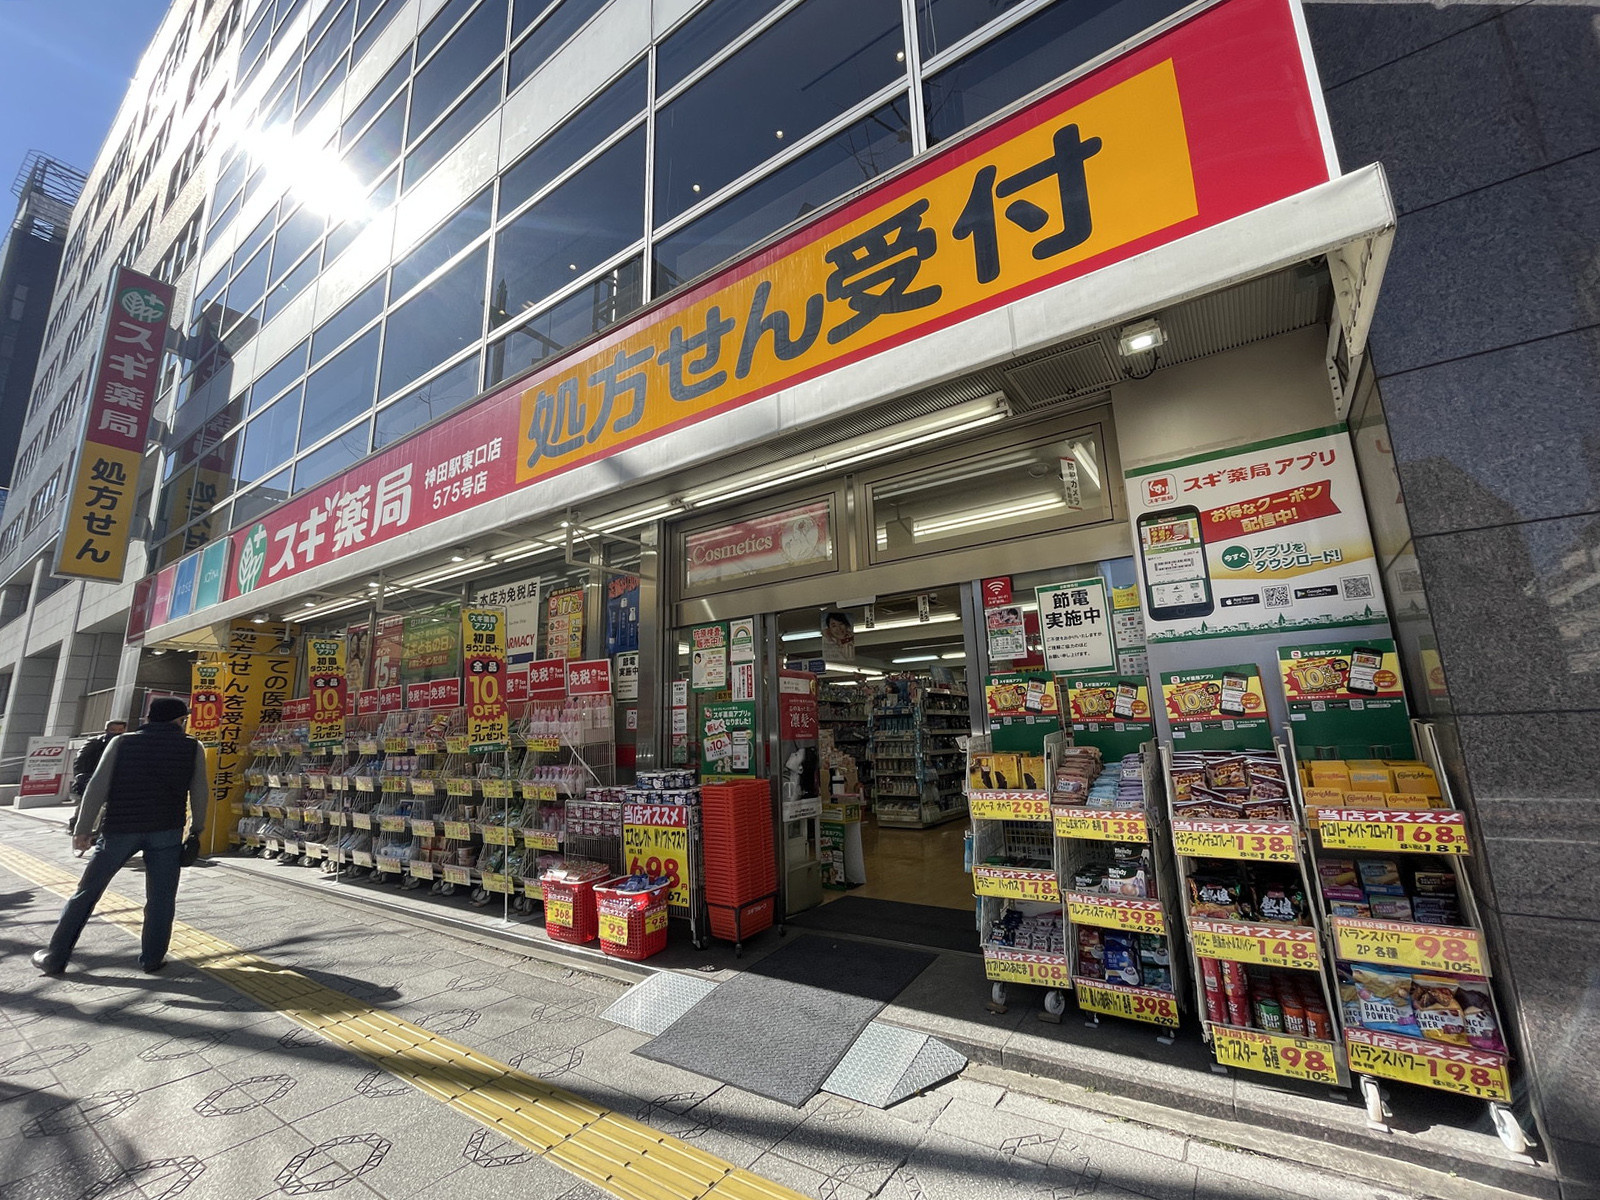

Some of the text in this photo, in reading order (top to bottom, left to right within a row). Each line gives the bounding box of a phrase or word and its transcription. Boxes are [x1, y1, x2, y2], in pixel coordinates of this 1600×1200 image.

[526, 122, 1102, 468] 処方せん受付
[98, 321, 155, 438] スギ薬局
[424, 437, 503, 489] 神田駅東口店
[1183, 449, 1336, 492] スギ薬局 アプリ
[433, 471, 488, 510] 575号店
[1066, 462, 1080, 505] 防犯カメラ
[76, 458, 127, 563] 処方せん
[1210, 485, 1323, 523] お得なクーポン
[268, 462, 413, 578] スギ薬局
[1241, 506, 1298, 533] 配信中!
[692, 533, 773, 565] Cosmetics
[1253, 543, 1304, 558] アプリを
[1224, 551, 1247, 563] 今すぐ
[1255, 549, 1342, 573] ダウンロード!
[480, 582, 538, 608] 本店为免税店
[1052, 589, 1089, 609] 節電
[1045, 607, 1101, 629] 実施中
[474, 623, 494, 631] アプリ
[473, 633, 496, 644] 初回
[472, 661, 498, 672] 全品
[530, 667, 549, 683] 免税
[570, 669, 591, 685] 免税
[431, 687, 446, 700] 免税
[506, 679, 514, 693] 税
[314, 710, 340, 721] OFF
[472, 705, 501, 717] OFF
[195, 720, 217, 728] OFF
[315, 724, 341, 732] クーポン
[474, 723, 503, 733] クーポン
[706, 721, 724, 732] 新しく
[471, 732, 506, 743] プレゼント
[32, 748, 62, 756] TKP
[969, 792, 1047, 800] 当店オススメ
[624, 805, 687, 825] 当店オススメ!
[1054, 809, 1143, 820] 当店オススメ
[1318, 810, 1461, 823] 当店オススメ
[1102, 821, 1146, 835] 138円
[1174, 821, 1290, 834] 当店オススメ
[1320, 822, 1393, 840] カロリーメイトブロック
[1394, 825, 1466, 844] 168円
[1236, 836, 1294, 852] 138円
[976, 868, 1056, 880] 当店オススメ
[1108, 867, 1127, 876] Blendy
[978, 877, 1020, 891] ラミー バッカス
[1019, 881, 1058, 894] 178円
[668, 891, 688, 904] 67円
[1068, 893, 1160, 910] 当店オススメ
[1118, 910, 1164, 927] 398円
[1192, 921, 1313, 940] 当店オススメ
[1336, 919, 1476, 939] 神田駅東口店オススメ!!
[1339, 928, 1412, 943] バランスパワー
[985, 951, 1065, 964] 当店オススメ
[1257, 940, 1318, 960] 148円
[1356, 944, 1399, 959] 2P 各種
[1414, 936, 1478, 964] 98円
[986, 961, 1028, 975] カプリコのあたま
[1028, 964, 1068, 979] 108円
[1443, 961, 1481, 974] 105円
[1133, 996, 1178, 1018] 398円
[1364, 1002, 1399, 1015] BALANCE
[1284, 1014, 1303, 1026] chip
[1365, 1011, 1395, 1021] POWER
[1217, 1037, 1257, 1062] チップスター
[1262, 1044, 1281, 1069] 各種
[1348, 1031, 1497, 1066] 当店オススメ
[1280, 1047, 1333, 1073] 98円
[1350, 1044, 1426, 1070] バランスパワー
[1304, 1070, 1337, 1083] 105円
[1427, 1059, 1501, 1087] 198円
